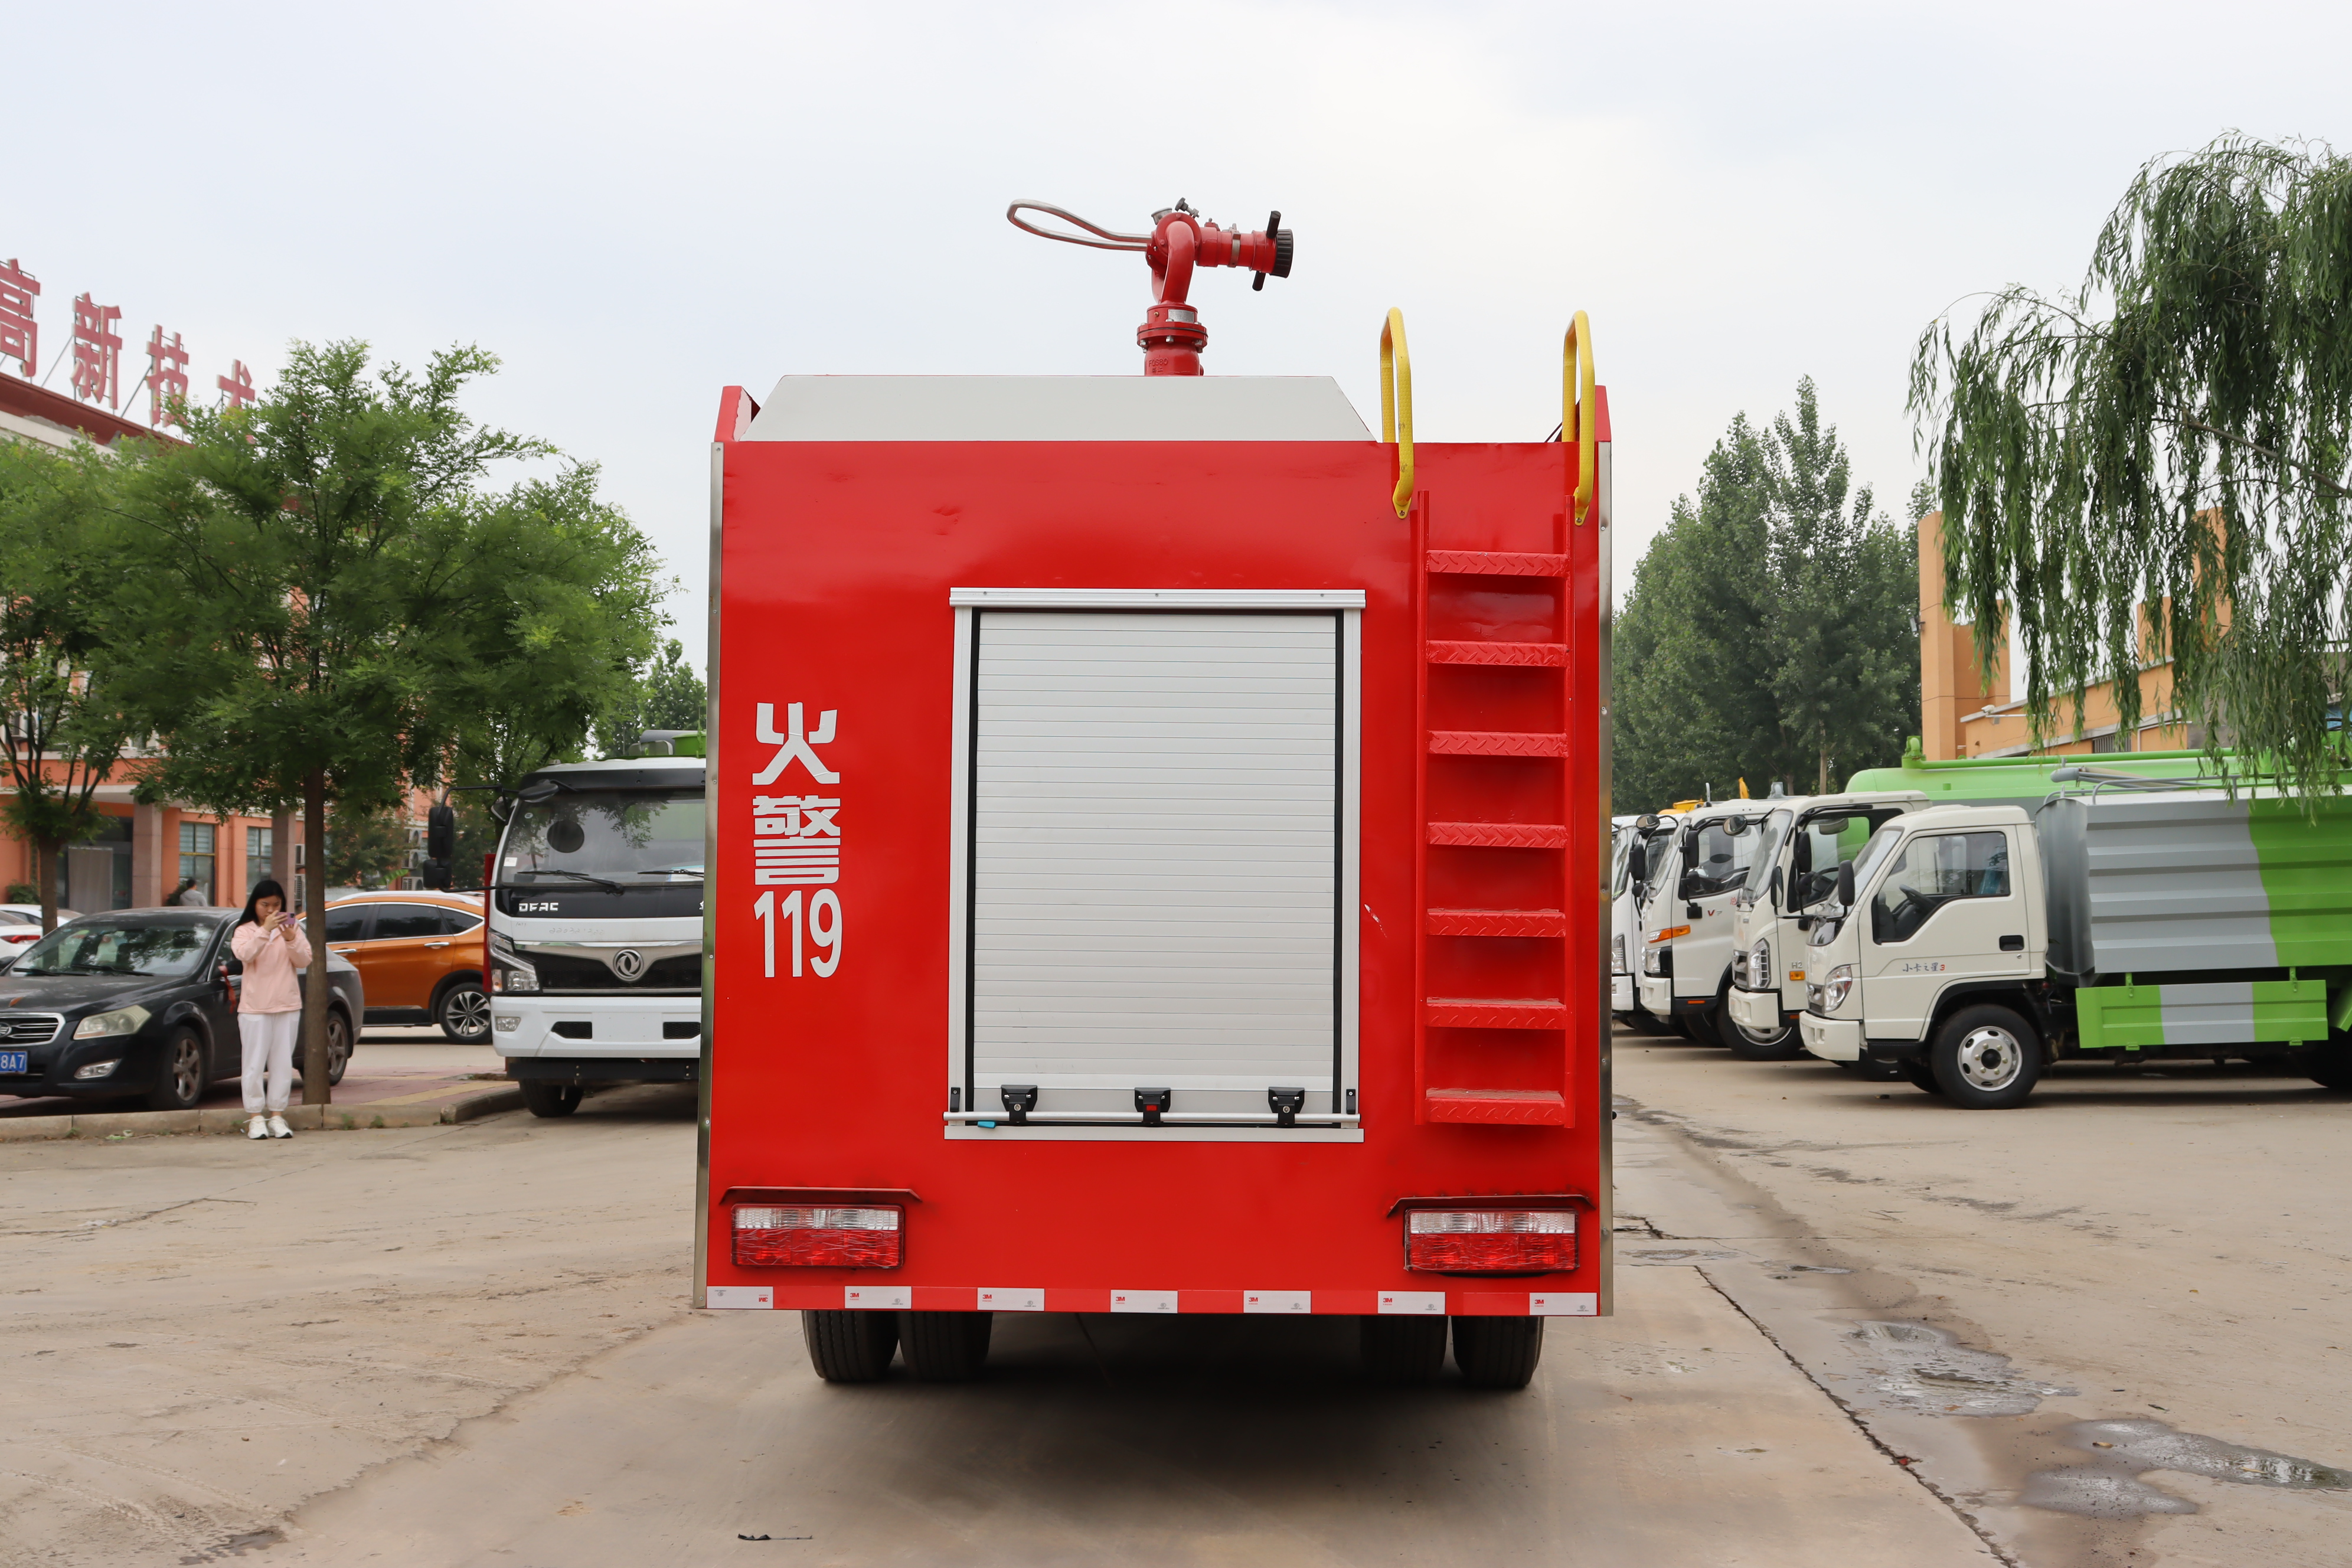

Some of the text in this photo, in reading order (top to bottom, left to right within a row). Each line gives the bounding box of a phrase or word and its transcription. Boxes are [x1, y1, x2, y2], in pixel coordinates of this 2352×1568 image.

[752, 701, 841, 886] 火警
[518, 902, 559, 912] DFAC
[753, 888, 842, 978] 119
